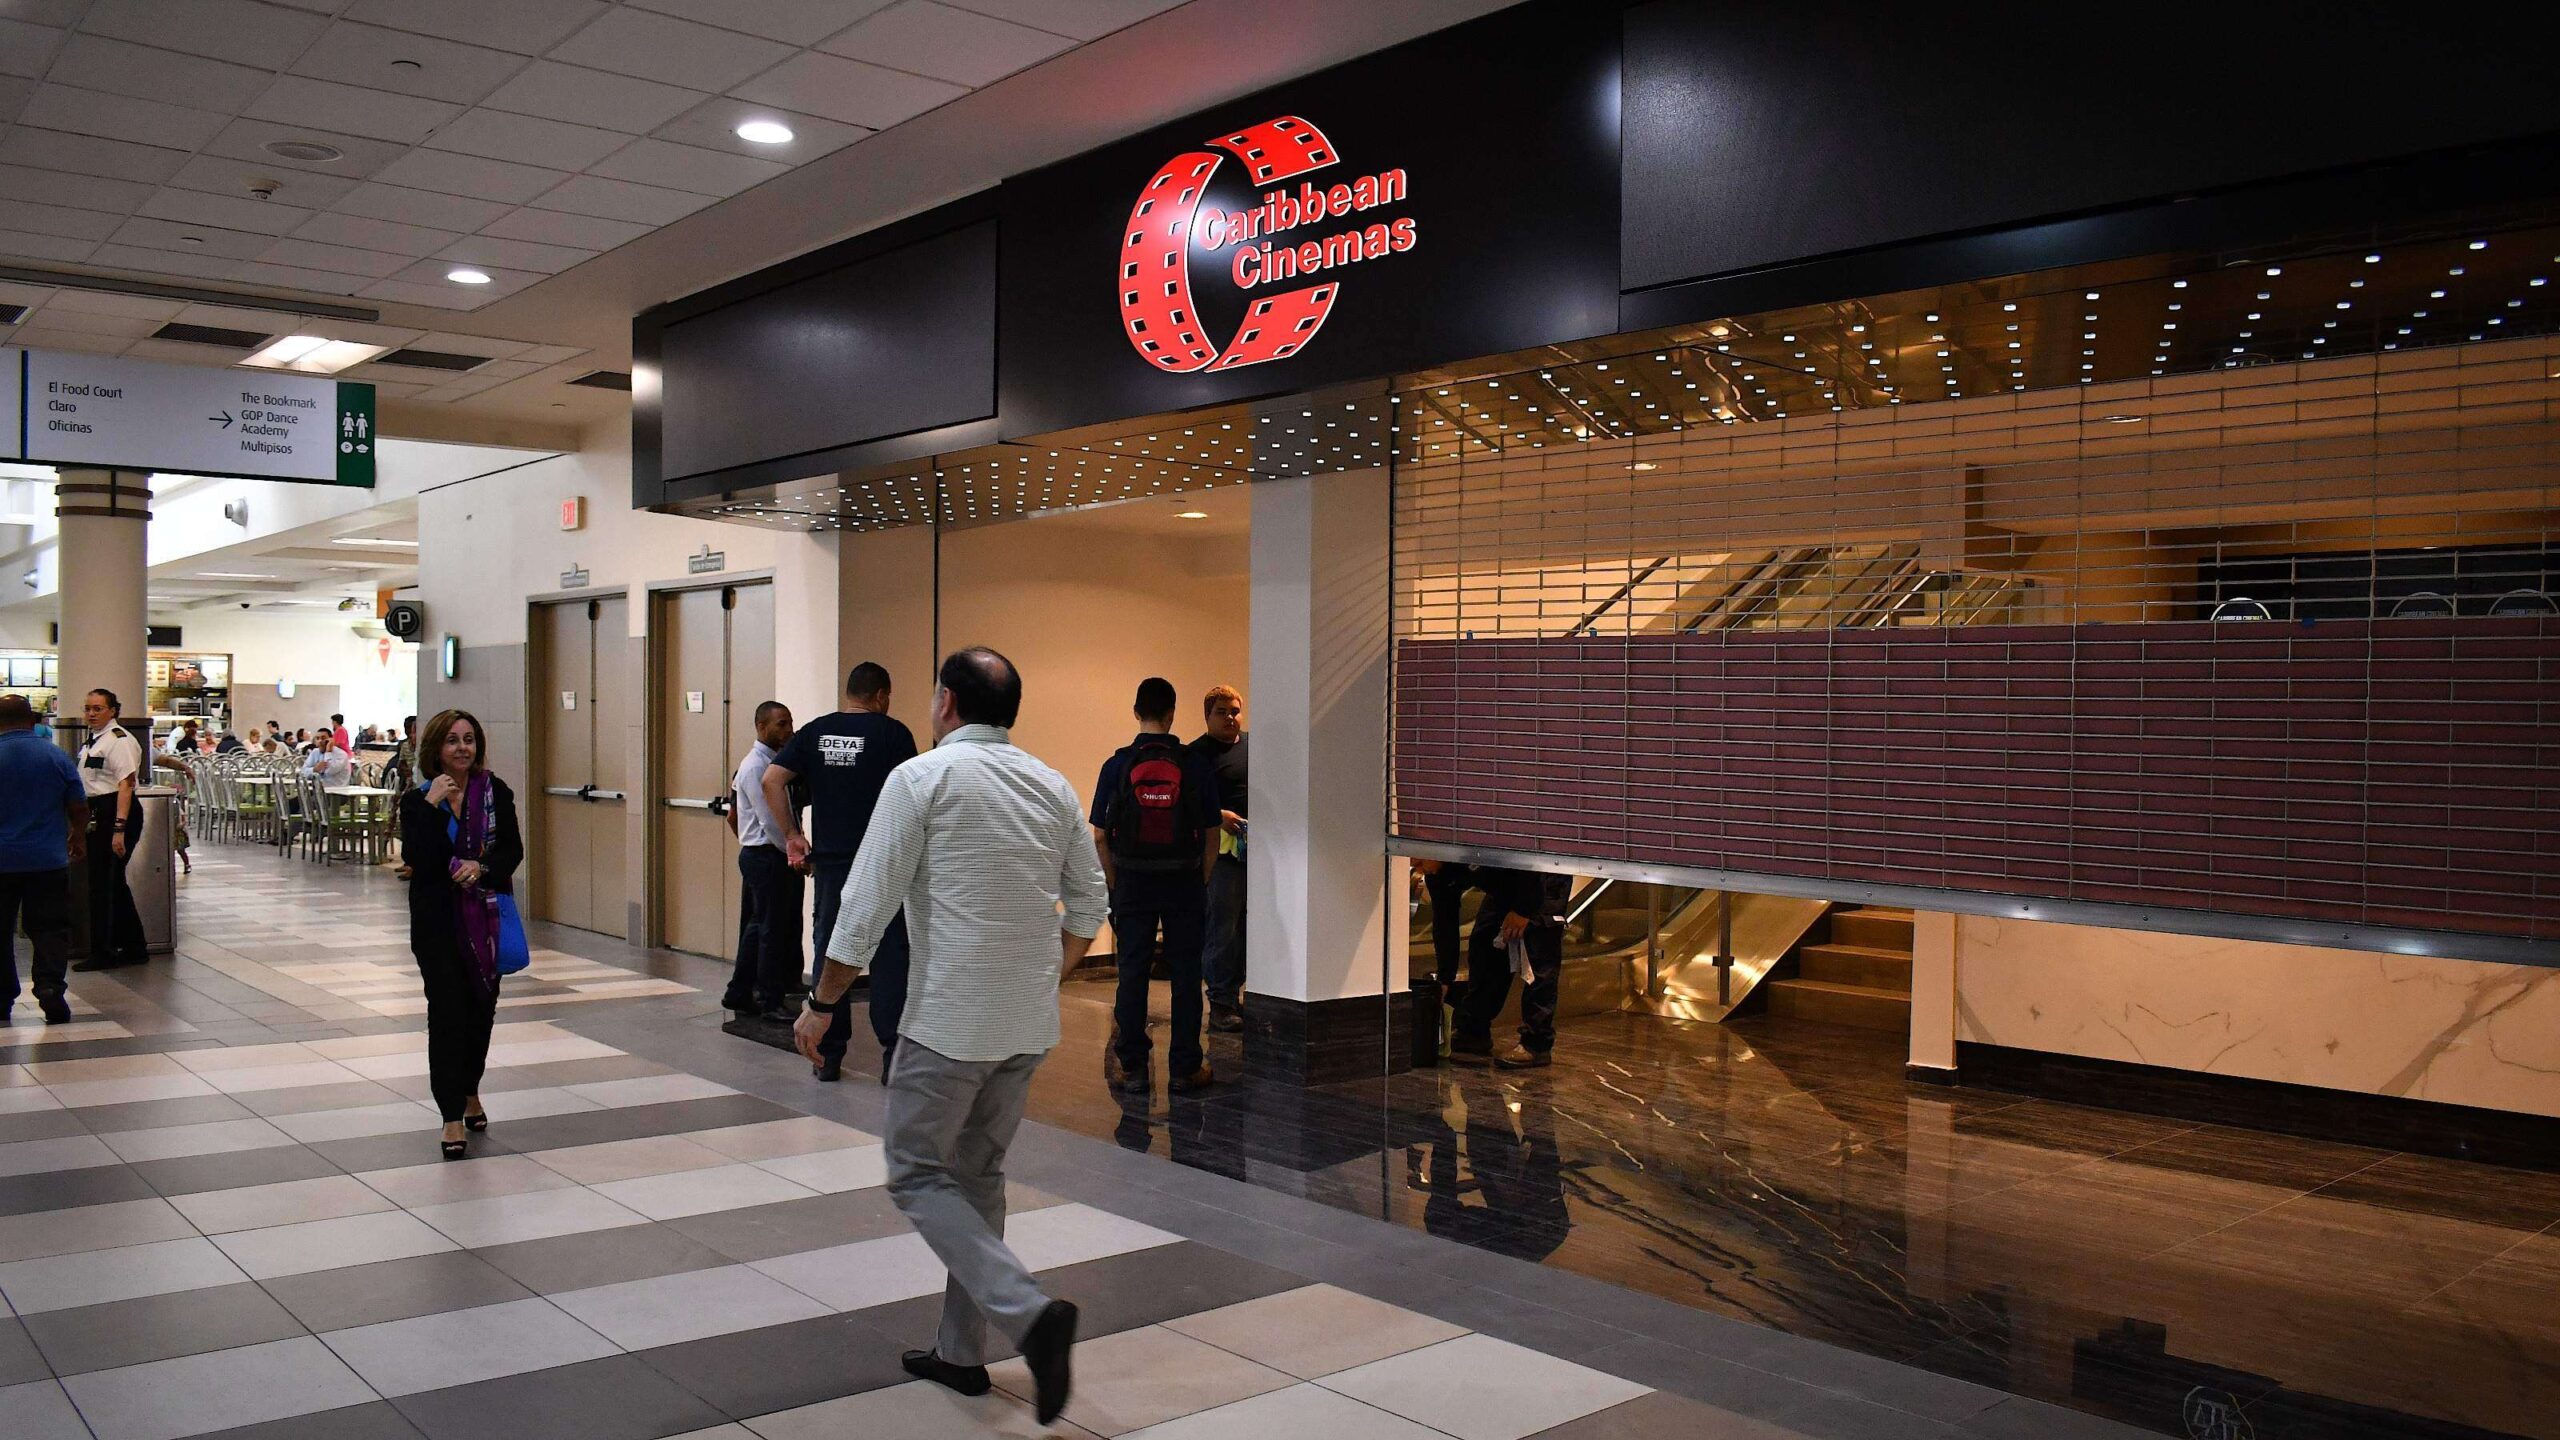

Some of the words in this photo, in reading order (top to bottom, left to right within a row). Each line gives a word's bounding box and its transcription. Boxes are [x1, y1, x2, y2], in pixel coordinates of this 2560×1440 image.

[1199, 168, 1407, 250] Caribbean
[1232, 217, 1416, 289] Cinemas
[49, 381, 58, 392] El
[62, 383, 89, 395] Food
[93, 386, 123, 399] Court
[49, 400, 77, 412] Claro
[241, 392, 260, 404] The
[264, 395, 317, 409] Bookmark
[241, 410, 263, 420] GOP
[267, 412, 298, 424] Dance
[49, 420, 93, 433] Oficinas
[241, 424, 289, 439] Academy
[241, 441, 293, 455] Multipisos
[398, 611, 411, 631] P
[823, 739, 857, 749] DEYA
